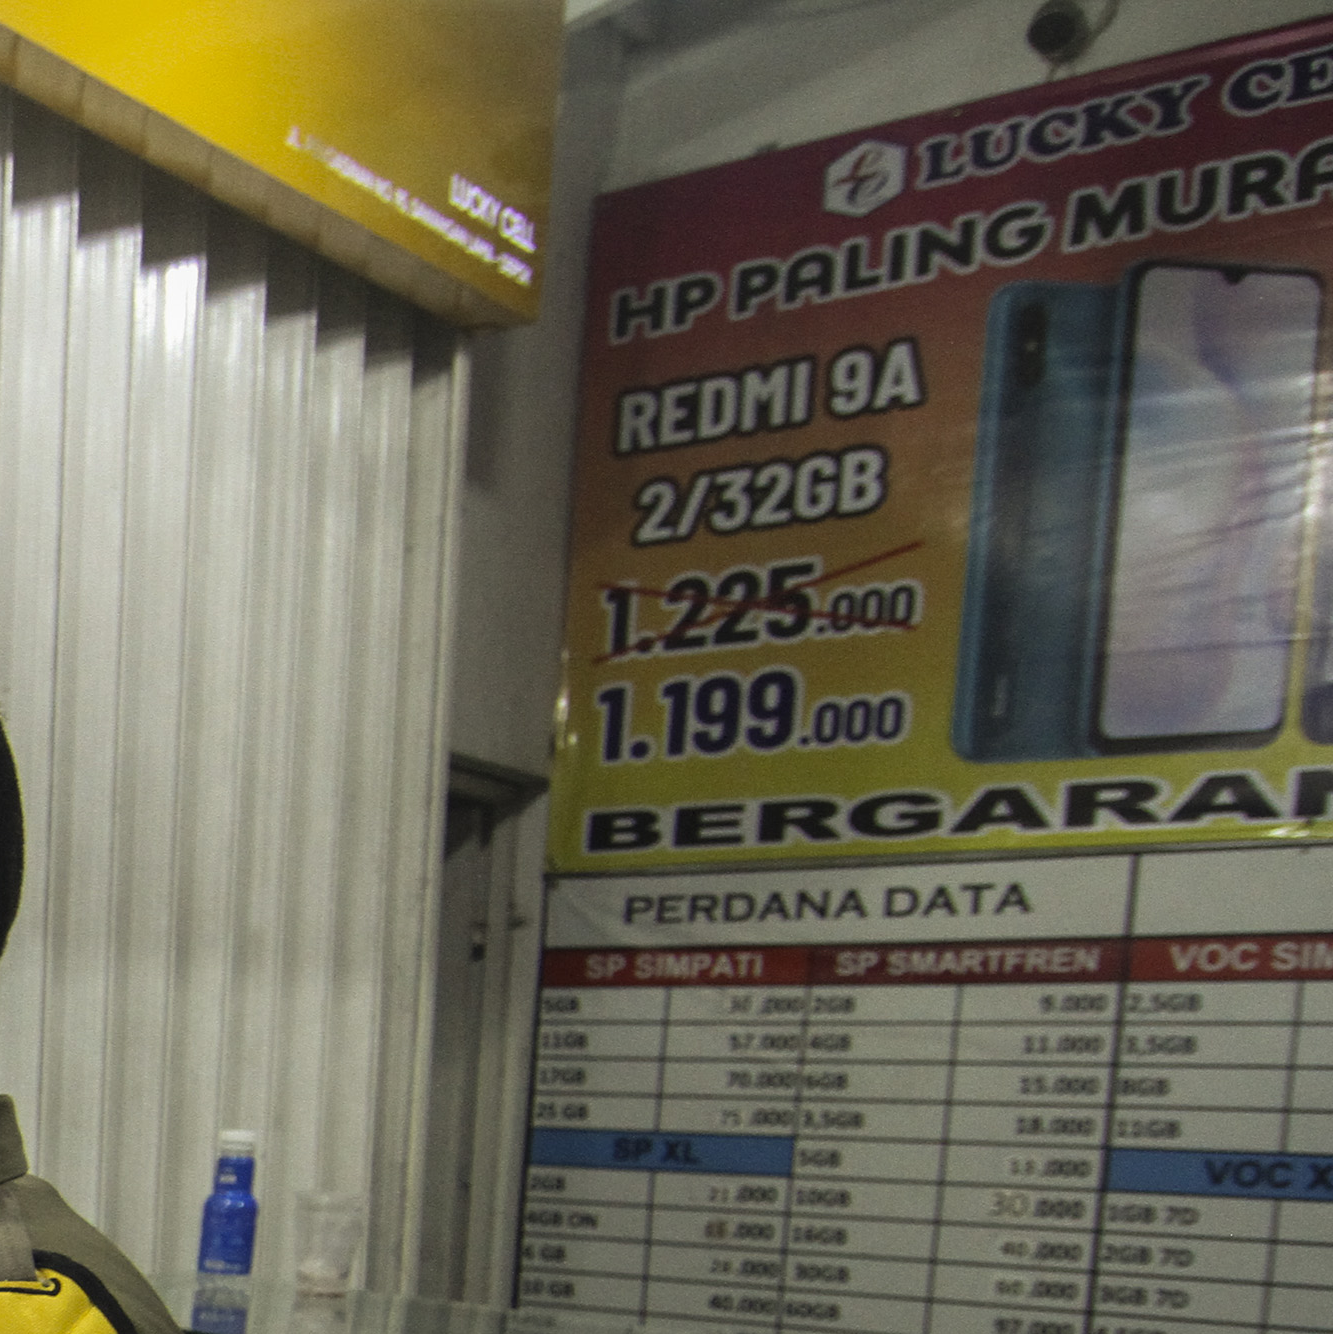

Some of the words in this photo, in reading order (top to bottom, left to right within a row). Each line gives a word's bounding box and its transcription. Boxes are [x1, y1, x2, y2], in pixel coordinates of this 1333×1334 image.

[918, 76, 1210, 189] LUCKY
[1222, 46, 1333, 117] CE
[610, 276, 721, 342] HP
[734, 206, 1054, 322] PALING
[1065, 137, 1333, 252] MURA
[616, 359, 814, 457] REDMI
[830, 337, 925, 417] 9A
[632, 448, 887, 546] 2/32GB
[603, 560, 921, 660] 1.225.000
[596, 669, 907, 764] 1.199.000
[623, 889, 866, 925] PERDANA
[883, 882, 1032, 919] DATA
[585, 953, 626, 979] SP
[635, 952, 764, 979] SIMPATI
[836, 950, 879, 977] SP
[885, 946, 1102, 977] SMARTFREN
[1169, 942, 1260, 972] VOC
[613, 1137, 653, 1161] SP
[662, 1139, 701, 1164] XL
[1204, 1160, 1294, 1188] VOC
